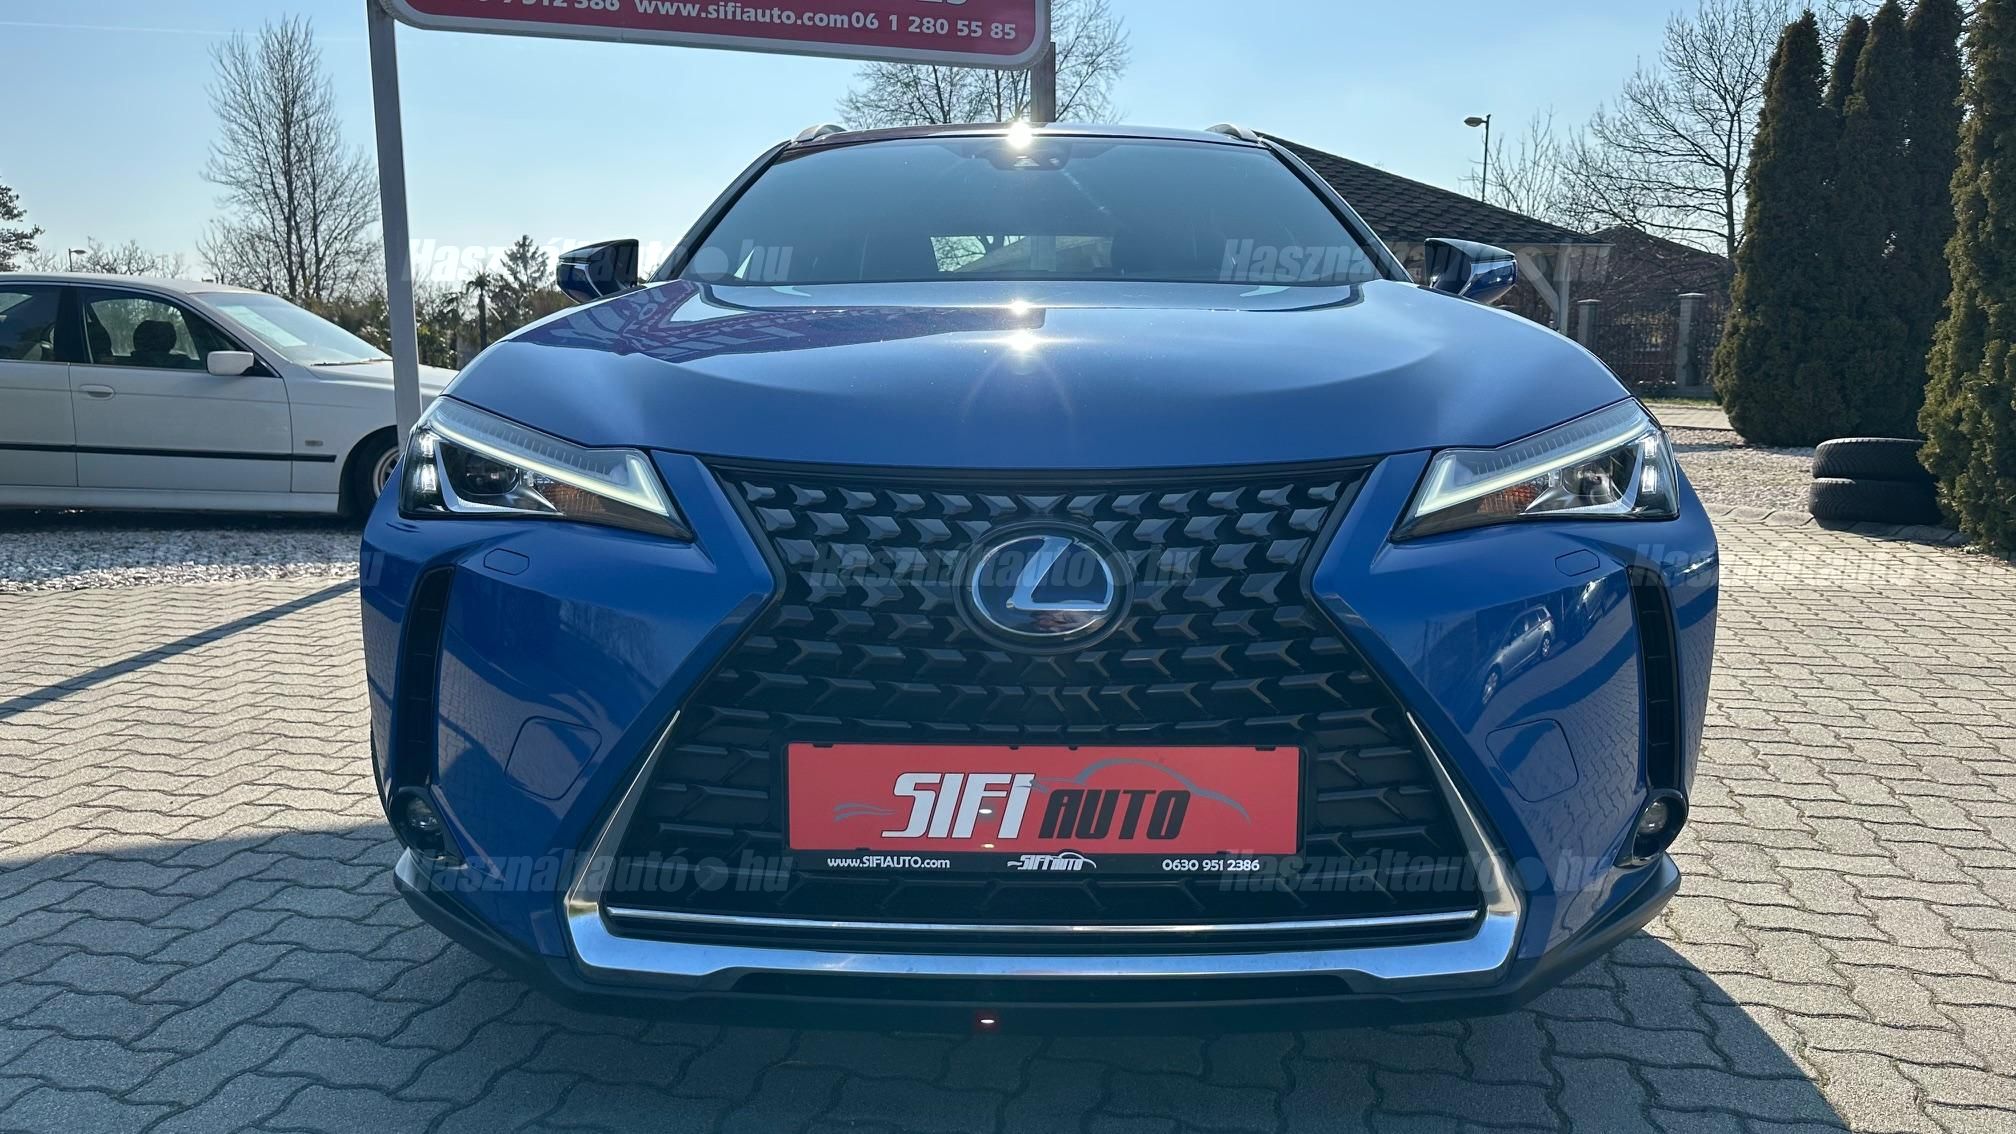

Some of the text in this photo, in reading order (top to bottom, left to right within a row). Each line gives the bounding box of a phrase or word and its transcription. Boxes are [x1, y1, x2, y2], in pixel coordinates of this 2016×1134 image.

[634, 0, 1016, 40] www.sifiauto.com 06 1 280 55 85
[1038, 789, 1192, 840] AUTO
[827, 855, 951, 869] www.SIFIAUTO.com
[1162, 859, 1260, 871] 0630 951 2386
